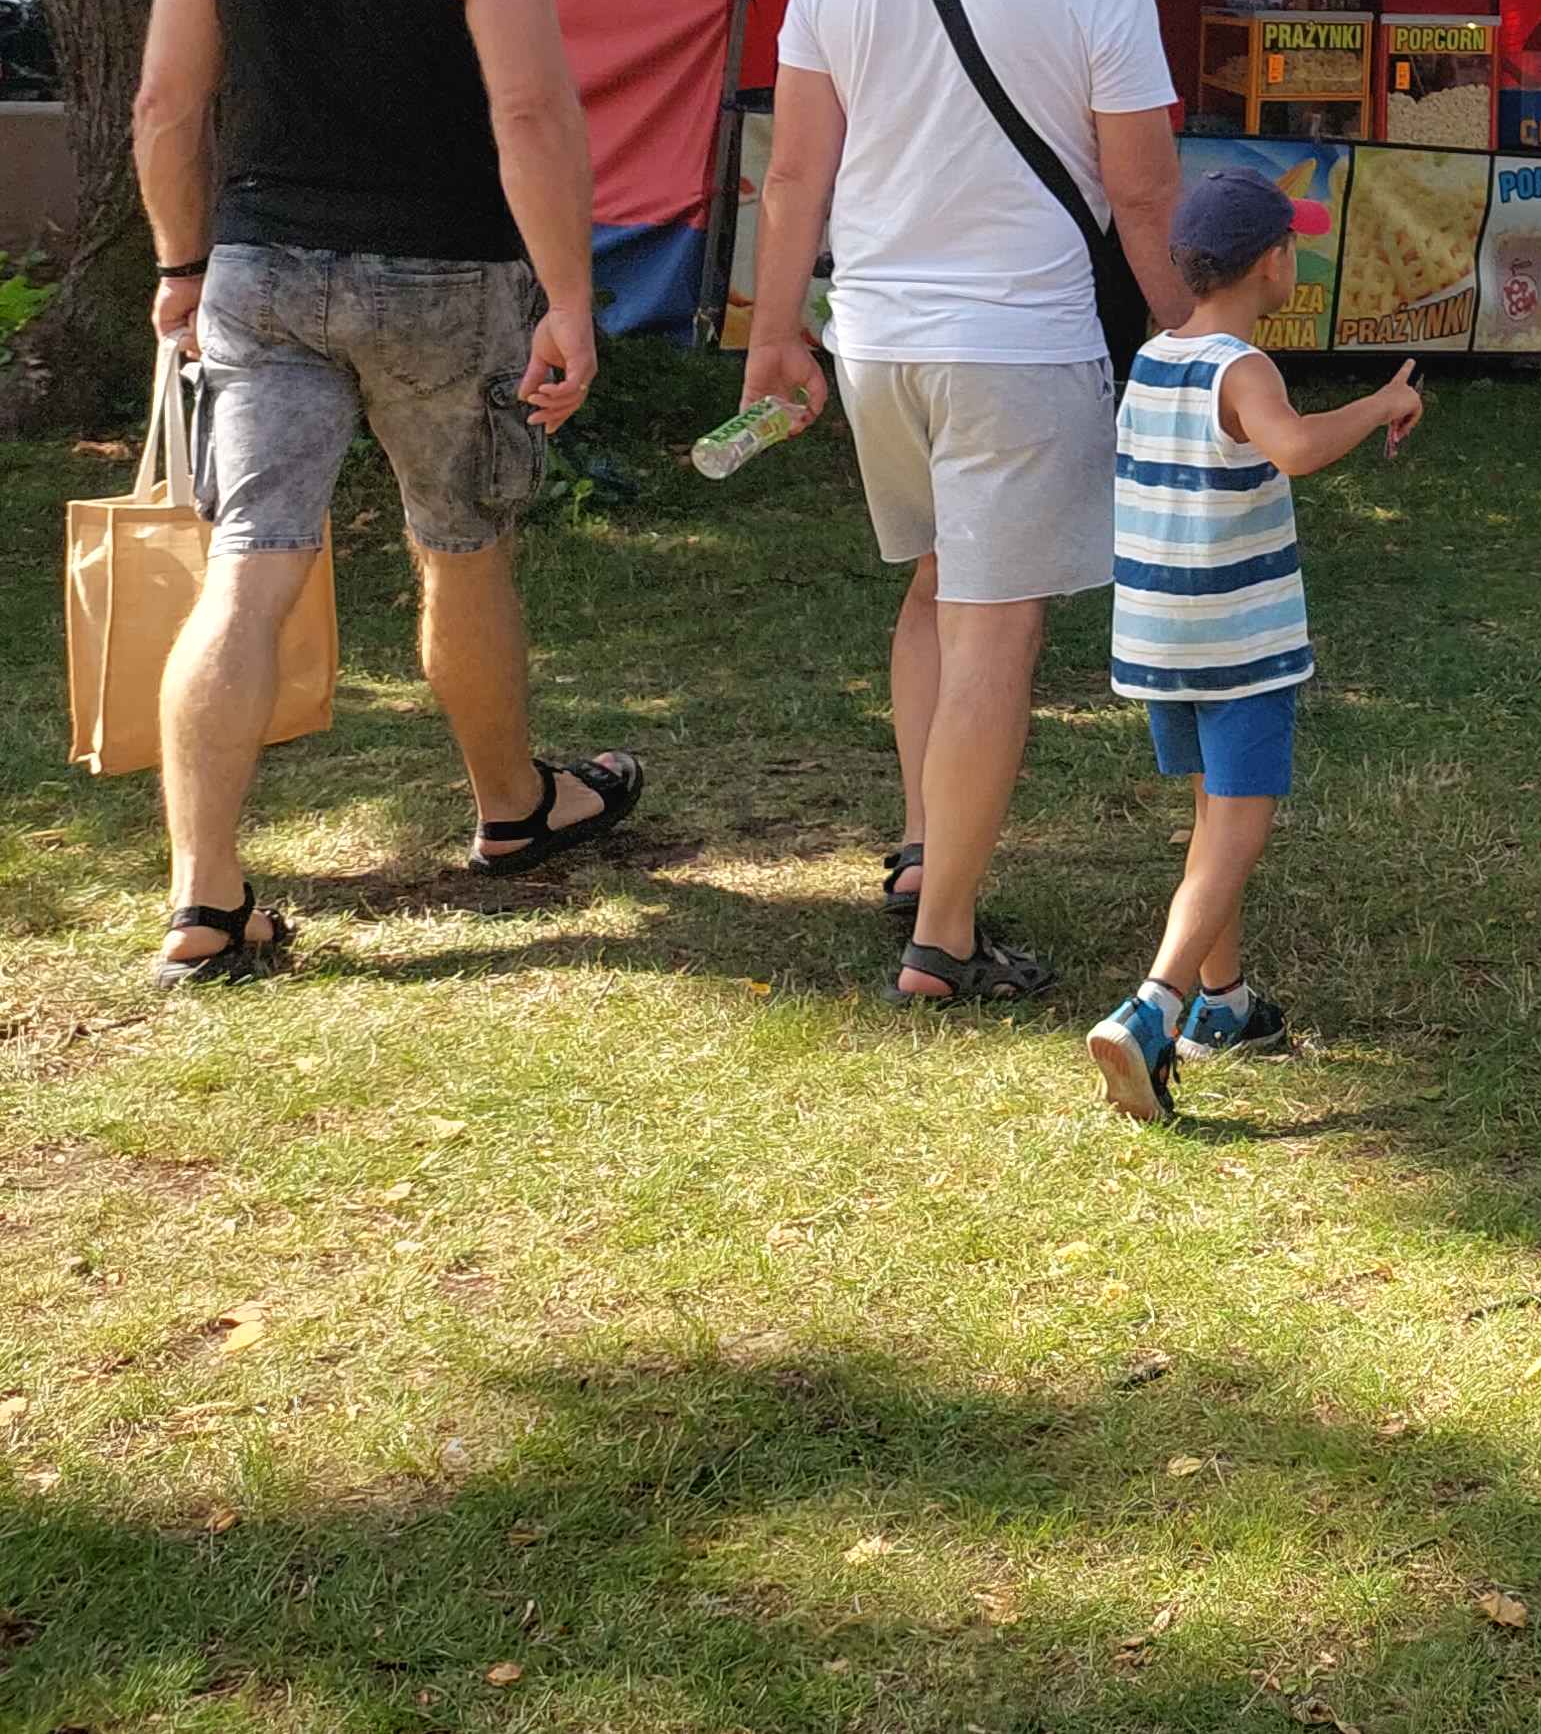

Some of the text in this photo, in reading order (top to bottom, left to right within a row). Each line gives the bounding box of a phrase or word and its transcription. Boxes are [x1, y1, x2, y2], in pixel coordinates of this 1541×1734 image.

[1264, 20, 1362, 50] PRAŻYNKI
[1395, 26, 1486, 52] POPCORN
[1339, 287, 1474, 346] PRAŻYNKI
